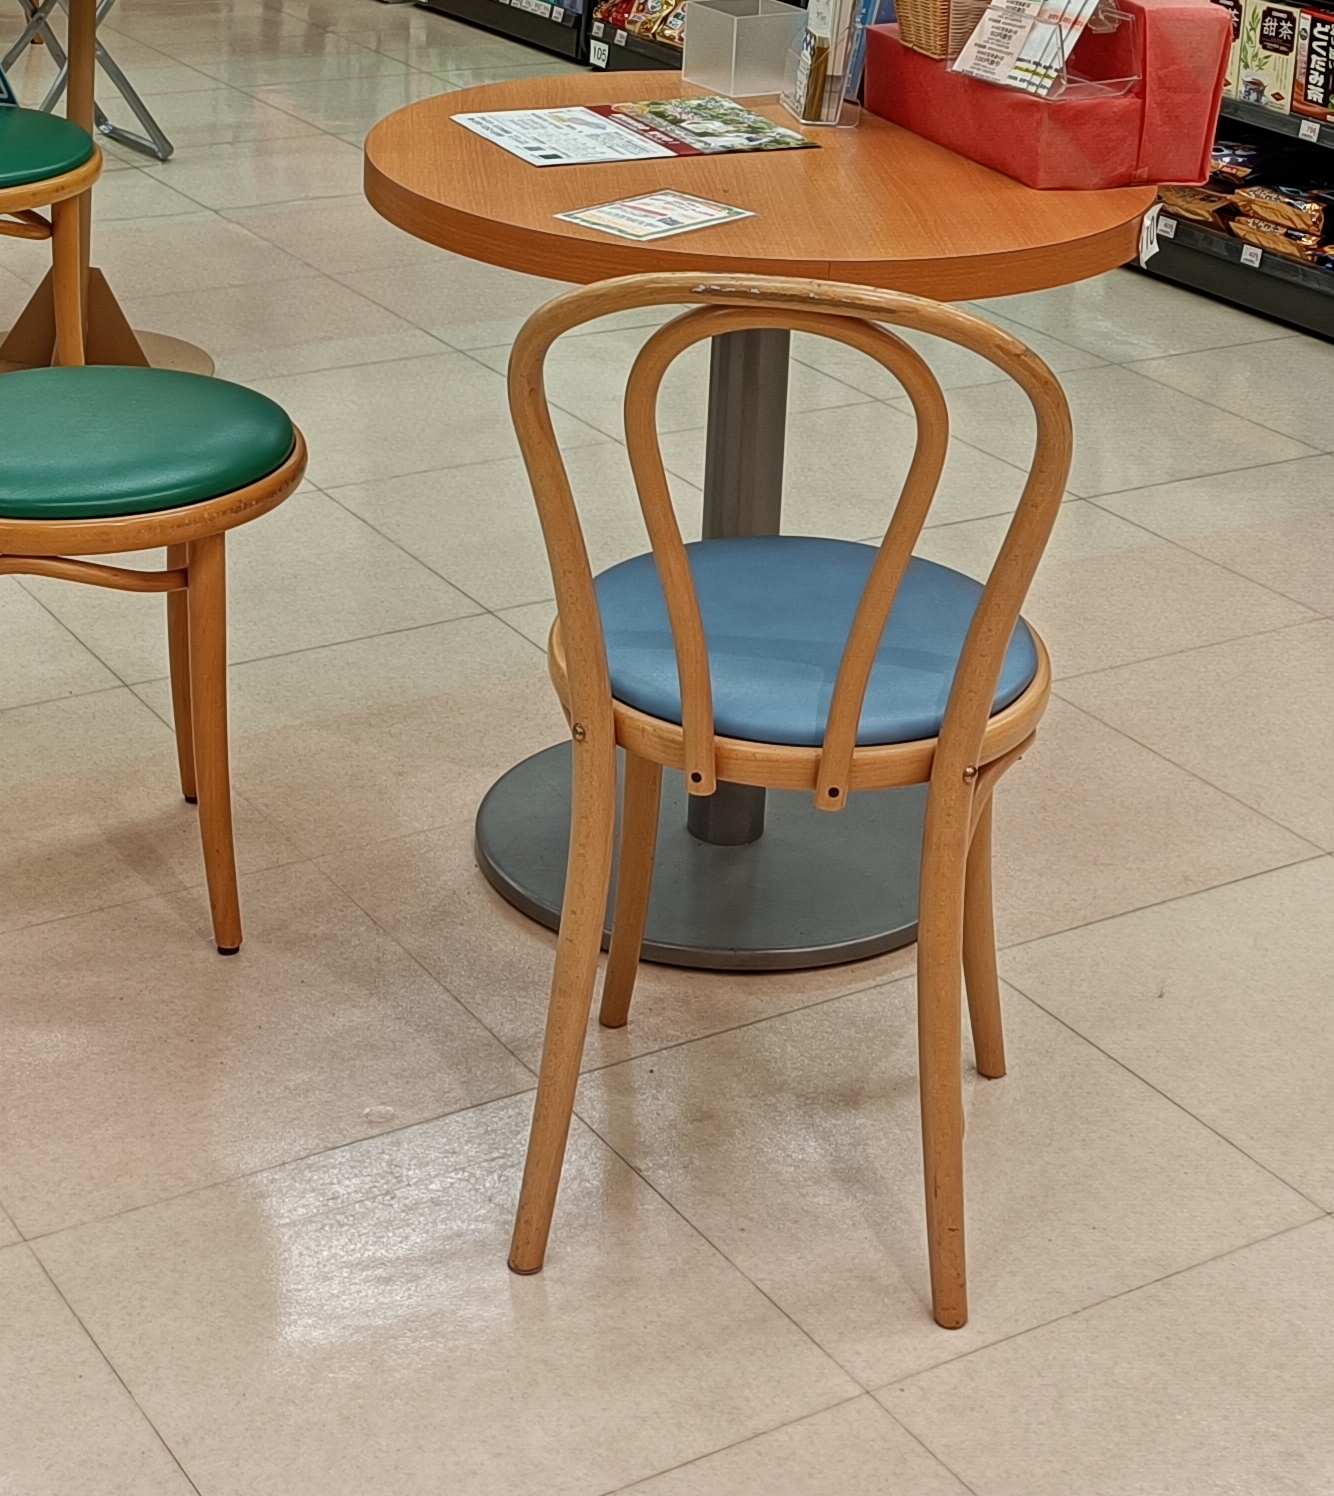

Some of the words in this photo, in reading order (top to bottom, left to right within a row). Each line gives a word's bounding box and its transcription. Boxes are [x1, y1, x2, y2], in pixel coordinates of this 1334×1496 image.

[592, 46, 608, 62] 105
[1308, 23, 1330, 104] どくだみ茶
